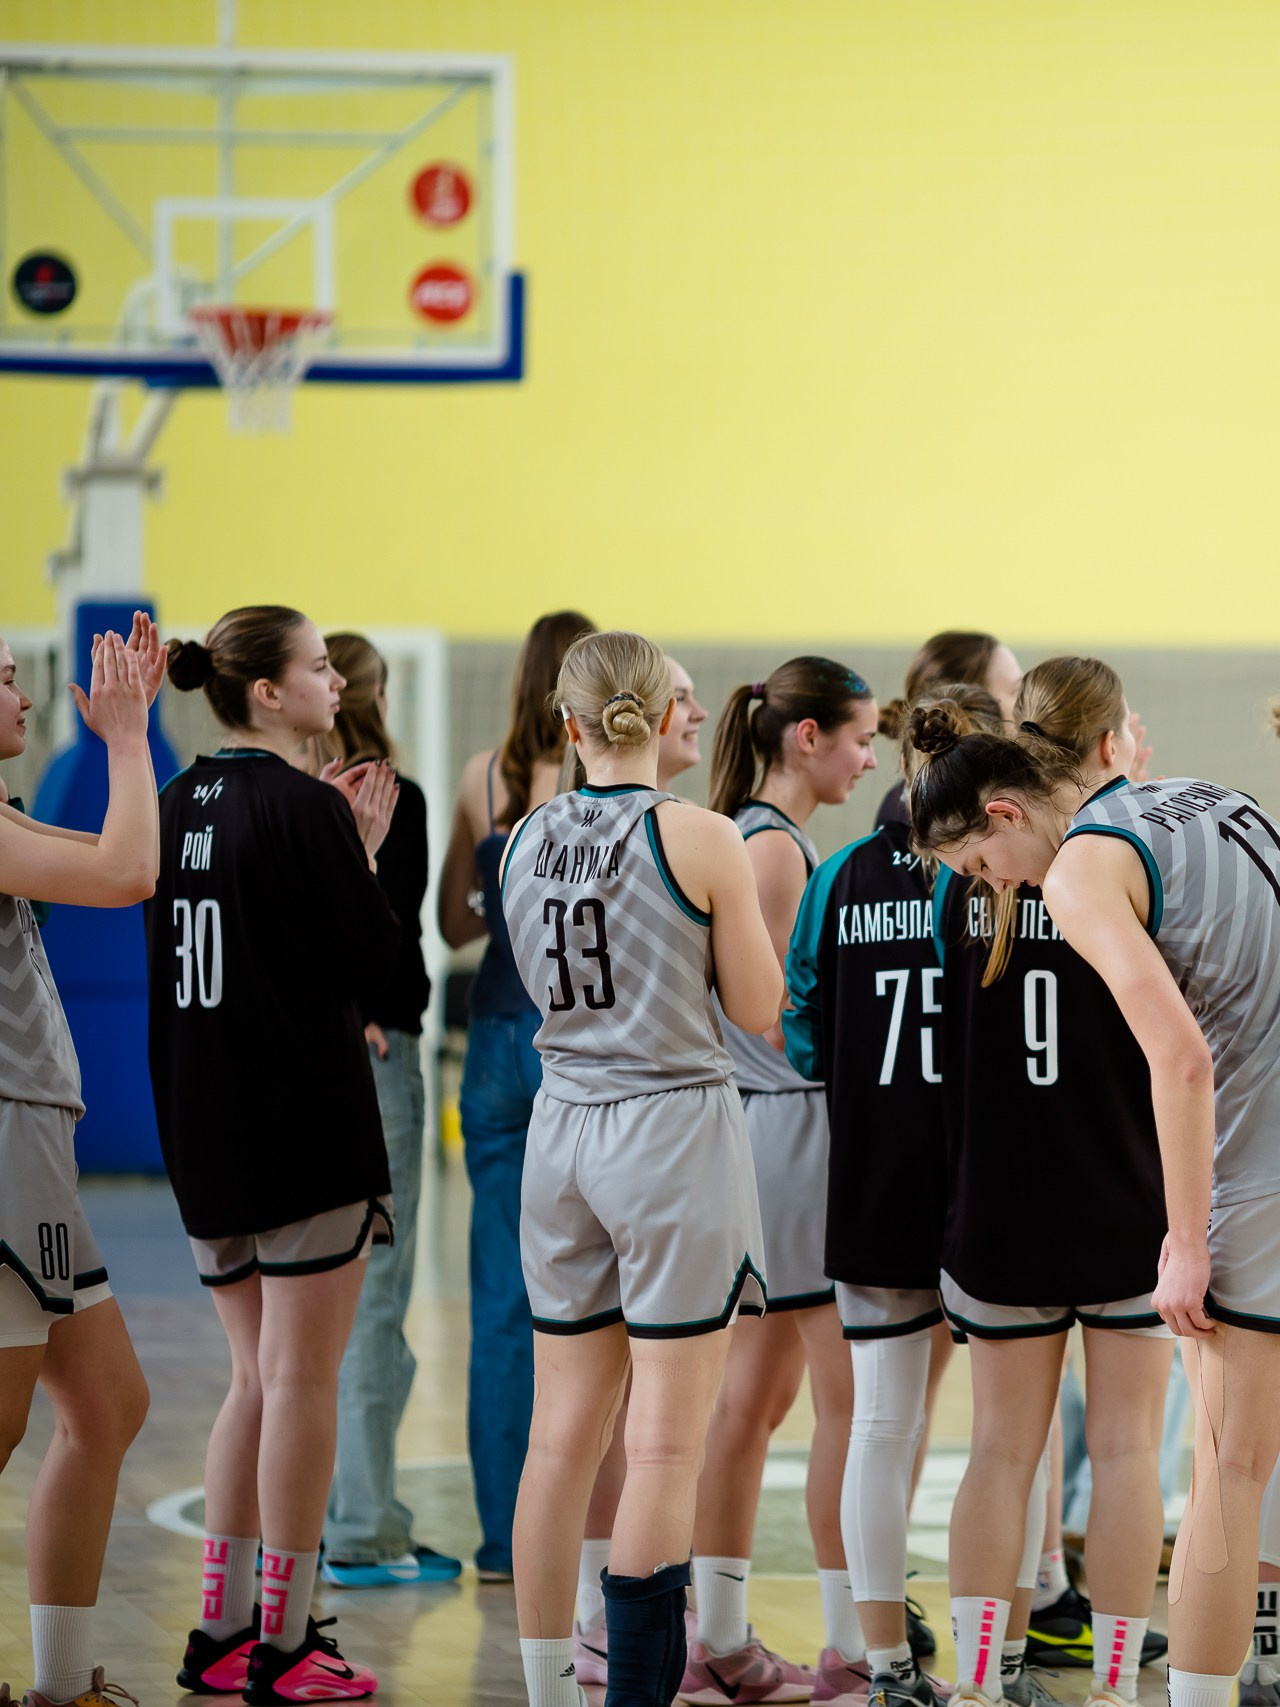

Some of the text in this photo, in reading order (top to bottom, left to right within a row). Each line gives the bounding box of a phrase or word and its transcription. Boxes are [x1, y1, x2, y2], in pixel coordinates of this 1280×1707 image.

[192, 777, 223, 806] 24/7
[181, 825, 213, 870] РОЙ
[892, 850, 931, 871] 24/
[173, 899, 223, 1009] 30
[543, 898, 616, 1012] 33
[876, 968, 943, 1085] 75
[1024, 969, 1058, 1085] 9
[38, 1222, 70, 1280] 80
